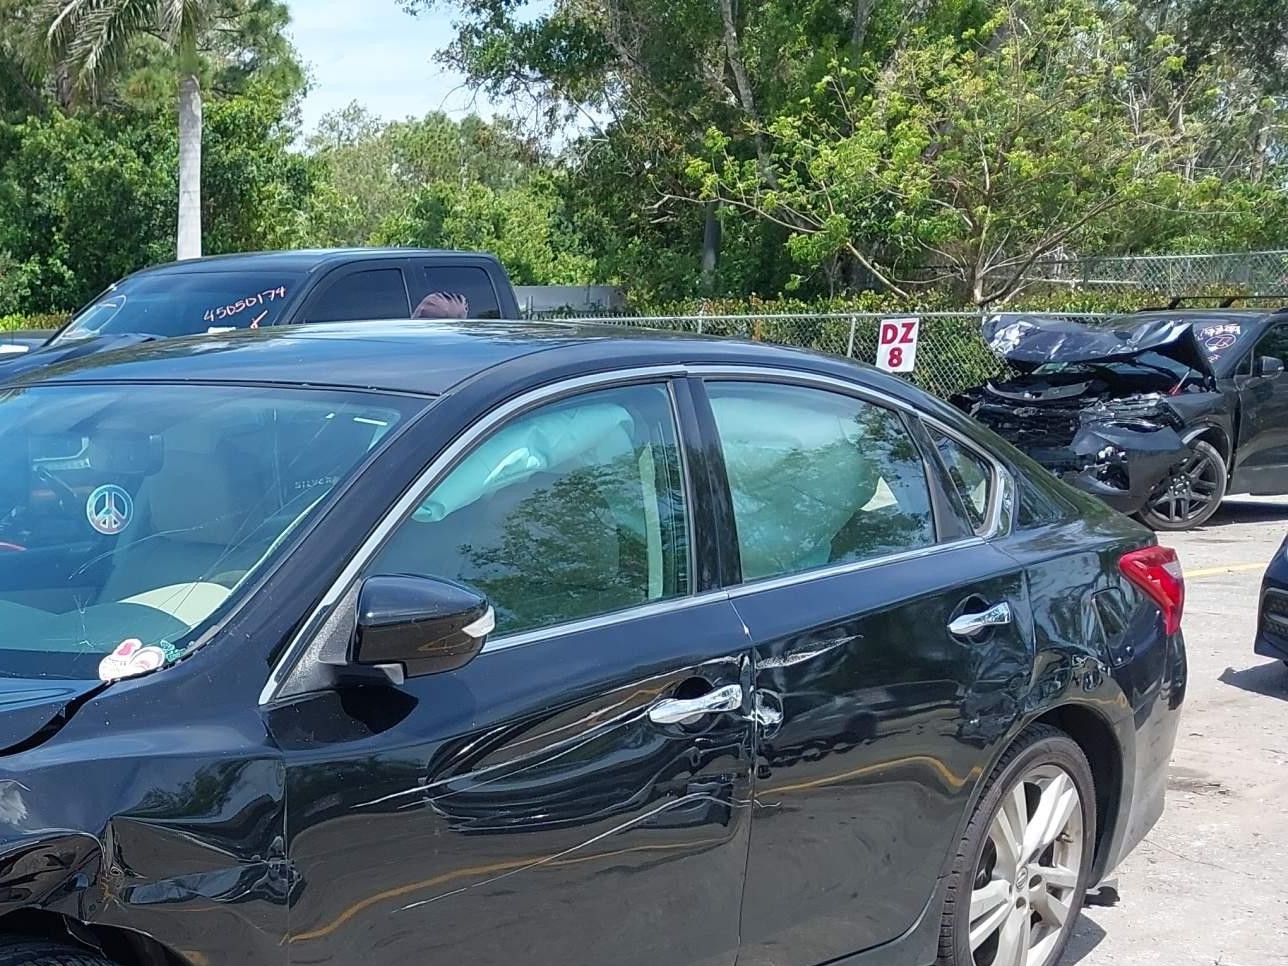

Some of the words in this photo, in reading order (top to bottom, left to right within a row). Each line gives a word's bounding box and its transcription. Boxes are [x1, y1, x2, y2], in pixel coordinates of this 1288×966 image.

[203, 285, 286, 322] 45050174
[881, 322, 916, 345] DZ
[887, 346, 903, 368] 8
